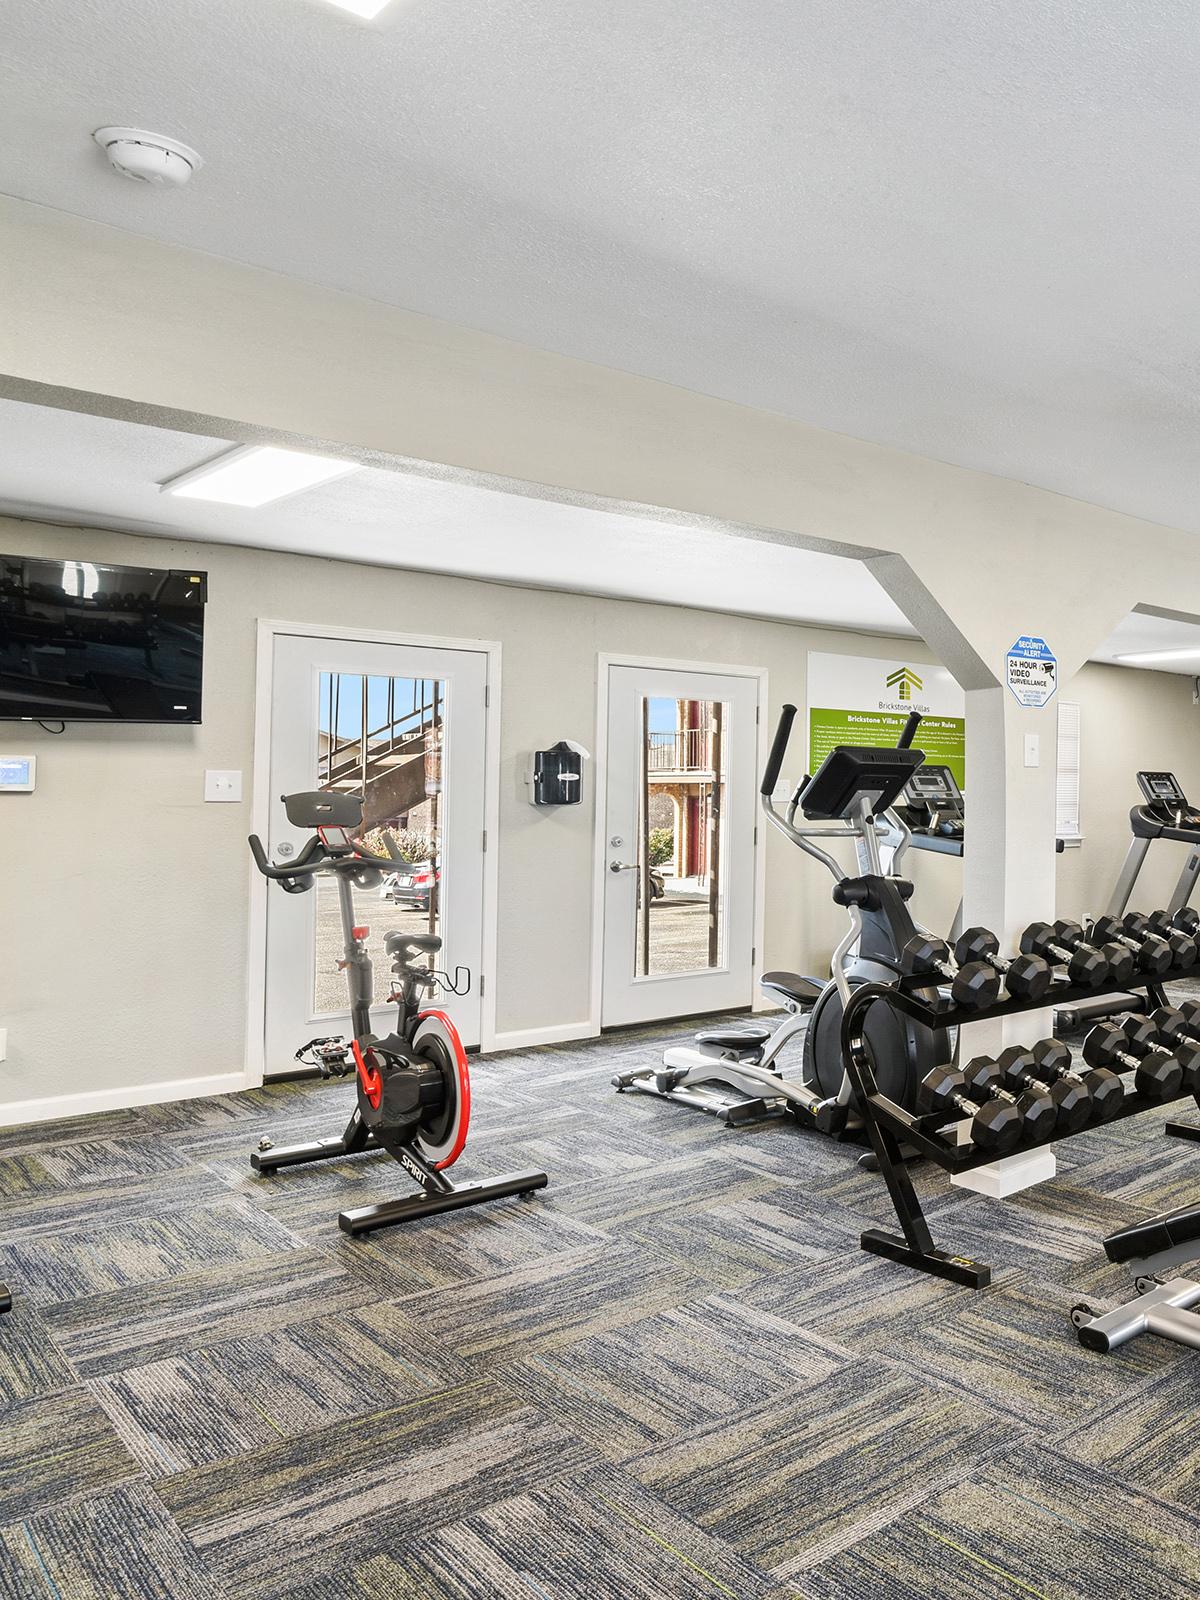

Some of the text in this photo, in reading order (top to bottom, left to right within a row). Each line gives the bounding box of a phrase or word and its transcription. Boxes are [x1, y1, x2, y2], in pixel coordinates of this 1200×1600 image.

[1018, 640, 1046, 650] SECURITY
[1023, 649, 1042, 658] ALERT
[1019, 661, 1038, 670] HOUR
[1010, 669, 1030, 678] VIDEO
[1010, 678, 1047, 687] SURVEILLANCE
[878, 701, 930, 712] Brickstone Villas
[847, 715, 880, 724] Brickstone
[881, 717, 899, 725] Villas
[921, 720, 941, 728] Center
[941, 721, 956, 729] Rules
[401, 1154, 428, 1184] SPIRIT
